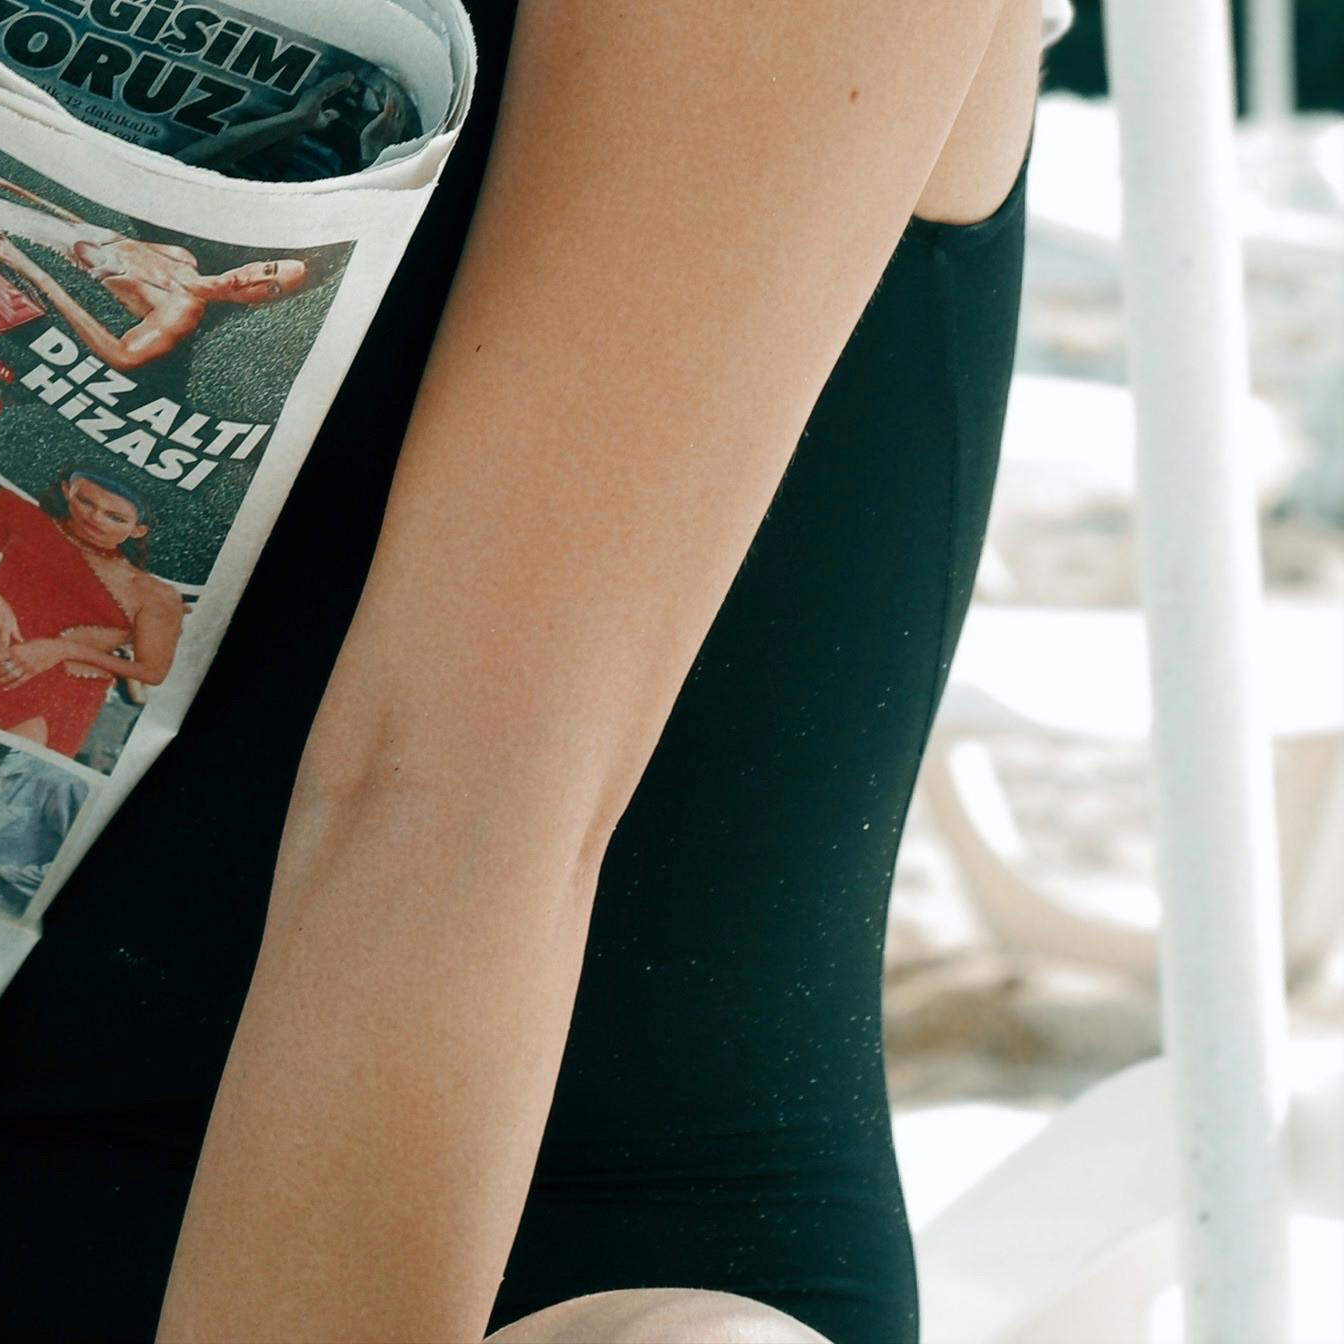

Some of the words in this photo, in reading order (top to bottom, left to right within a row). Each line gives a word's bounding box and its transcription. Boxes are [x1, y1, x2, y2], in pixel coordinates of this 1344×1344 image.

[20, 363, 218, 492] HİZASI
[27, 326, 137, 408] DİZ
[126, 392, 271, 462] ALTI
